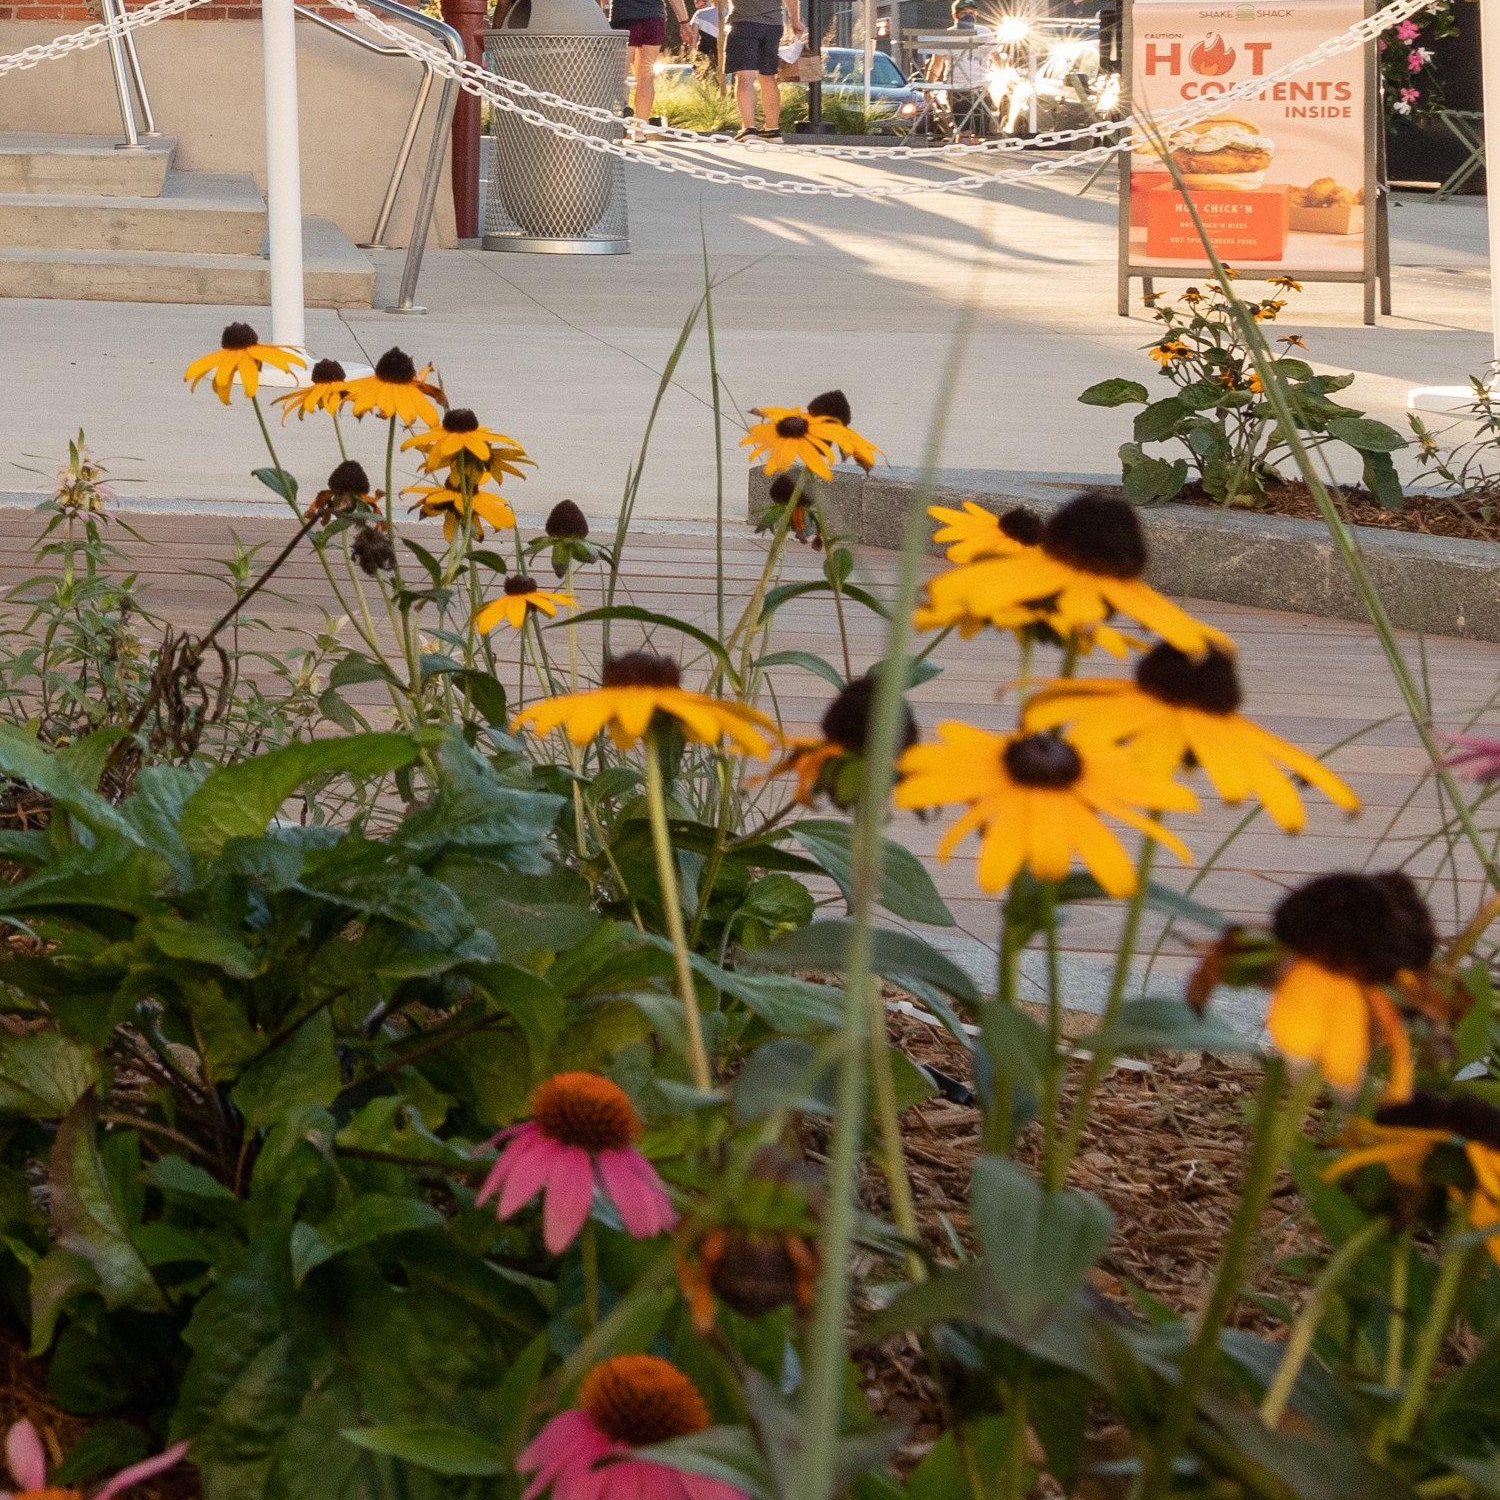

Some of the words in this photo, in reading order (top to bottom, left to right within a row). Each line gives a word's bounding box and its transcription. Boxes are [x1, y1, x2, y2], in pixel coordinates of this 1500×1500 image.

[1198, 10, 1234, 19] SHAKE
[1256, 9, 1292, 18] SHACK
[1145, 39, 1272, 76] HOT
[1285, 106, 1352, 119] INSIDE
[1204, 204, 1253, 214] CHICK'N
